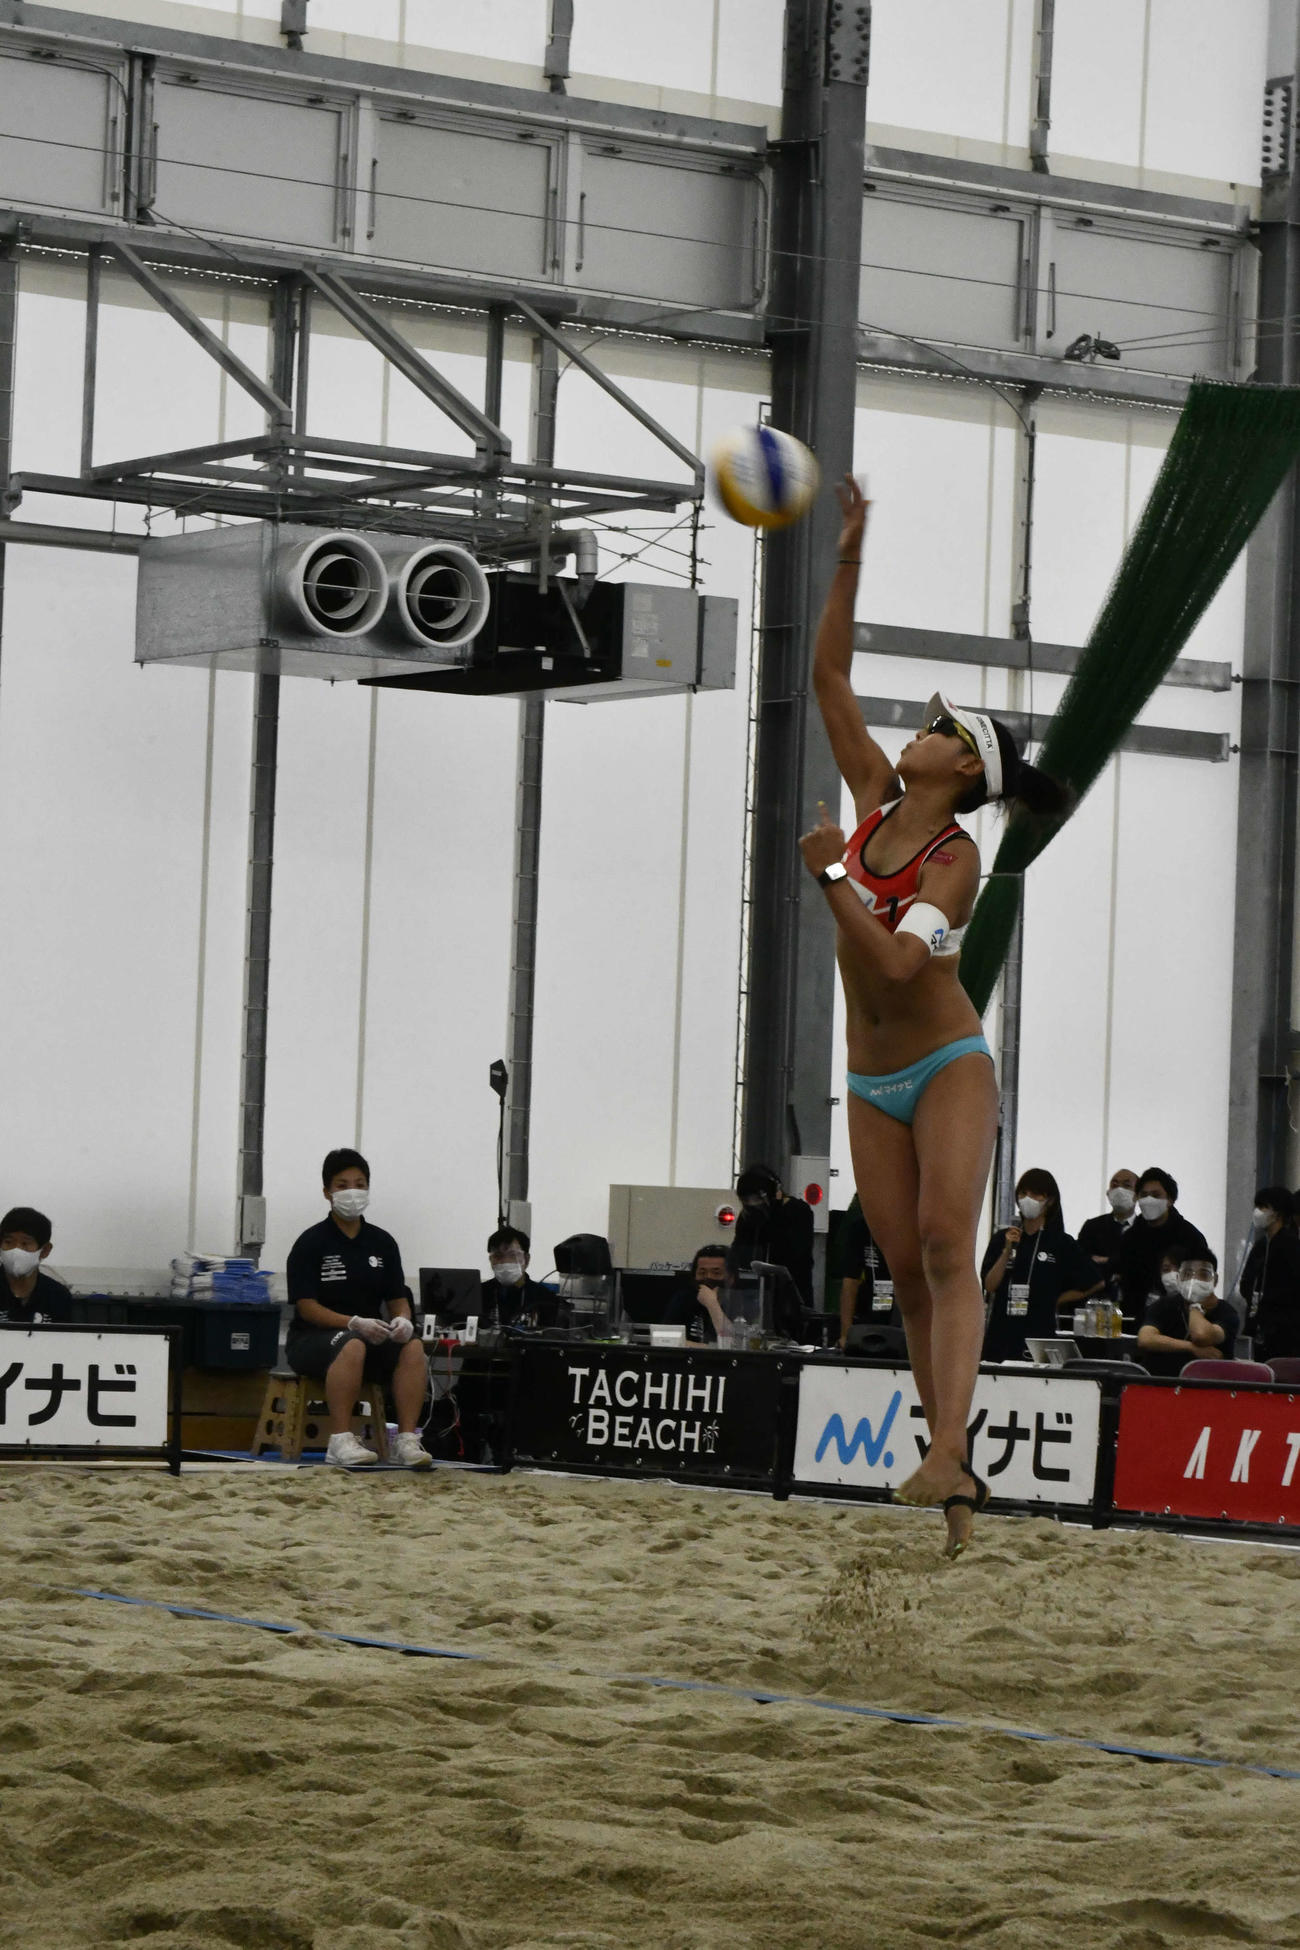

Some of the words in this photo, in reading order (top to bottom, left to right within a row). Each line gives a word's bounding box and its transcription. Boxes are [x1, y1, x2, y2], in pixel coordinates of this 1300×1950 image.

[886, 896, 899, 922] 1
[568, 1366, 726, 1413] TACHIHI
[586, 1408, 702, 1453] BEACH
